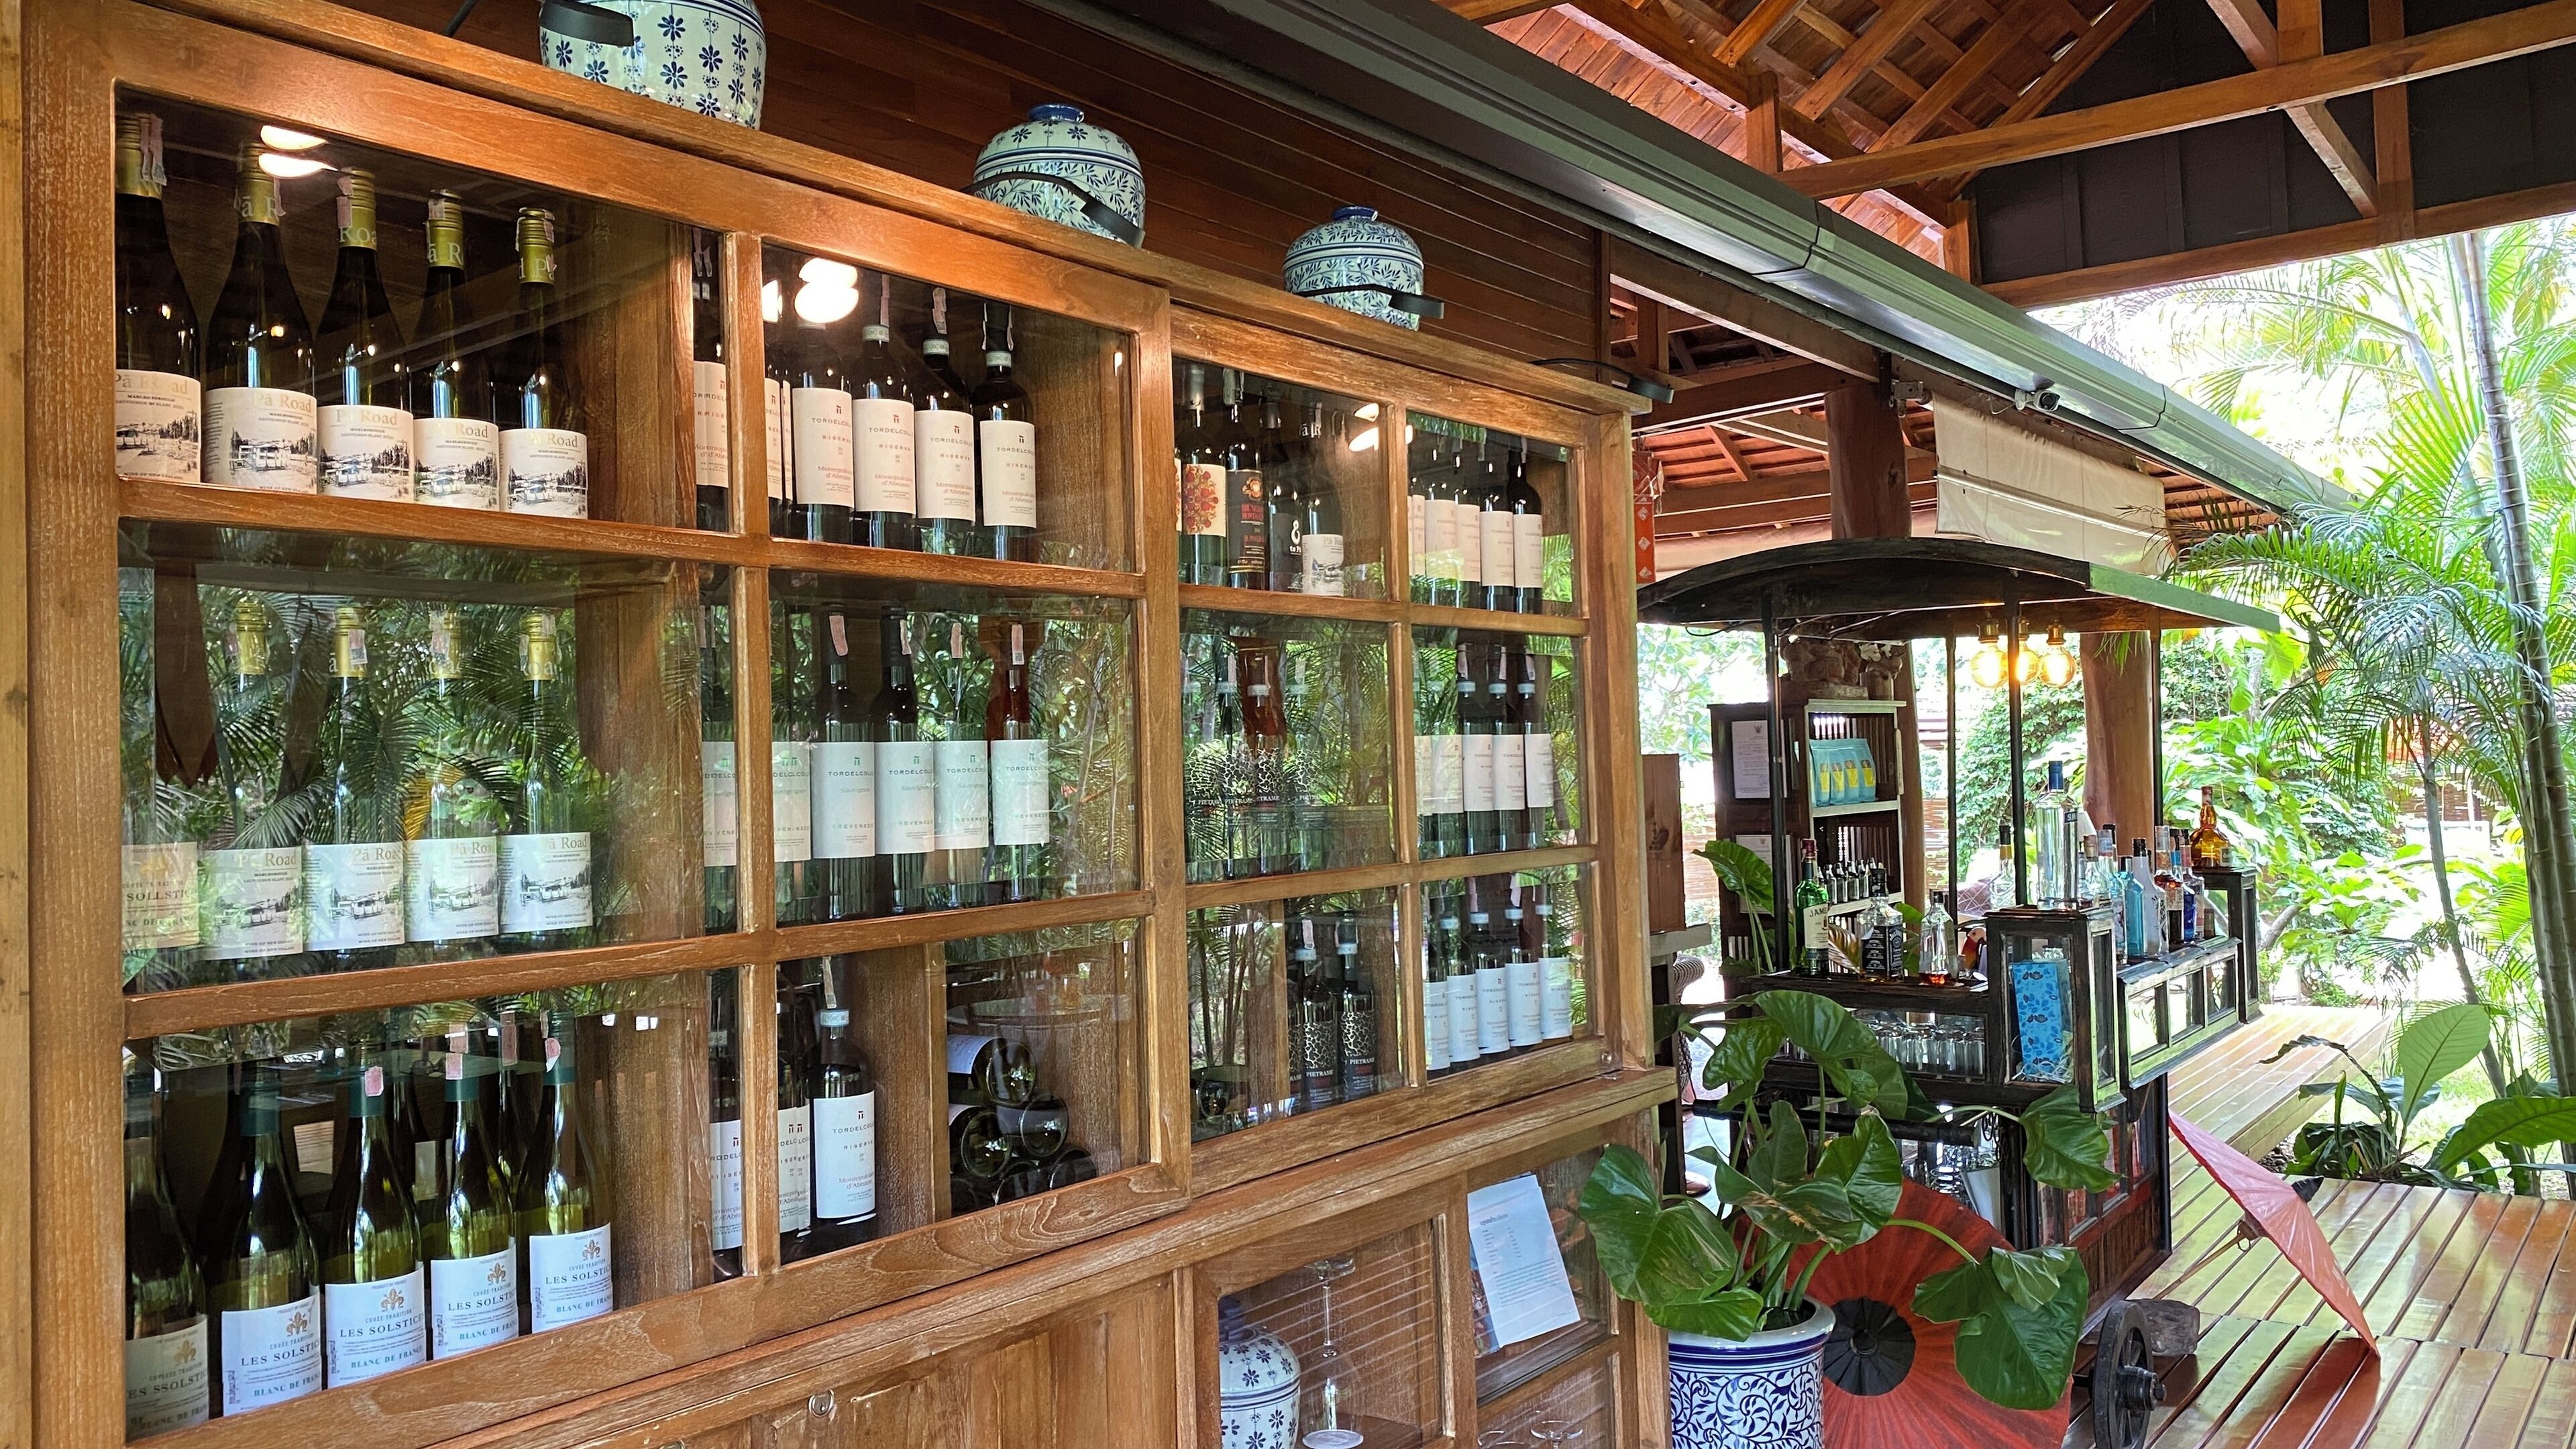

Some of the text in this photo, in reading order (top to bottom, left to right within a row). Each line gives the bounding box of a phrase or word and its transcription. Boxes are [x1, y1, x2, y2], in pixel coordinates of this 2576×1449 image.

[280, 394, 312, 413] Road
[361, 409, 397, 426] Road
[455, 422, 488, 438] Road
[547, 433, 578, 448] Road
[1291, 519, 1301, 545] 8
[561, 835, 588, 850] Road
[264, 850, 297, 867] Road
[545, 1275, 568, 1285] LES
[447, 1301, 471, 1311] LES
[556, 1303, 583, 1313] BLANC
[586, 1299, 594, 1308] DE
[340, 1328, 364, 1338] LES
[460, 1329, 488, 1340] BLANC
[490, 1326, 499, 1334] DE
[241, 1355, 268, 1366] LES
[351, 1358, 380, 1369] BLANC
[384, 1354, 396, 1363] DE
[254, 1384, 286, 1397] BLANC
[289, 1381, 301, 1389] DE
